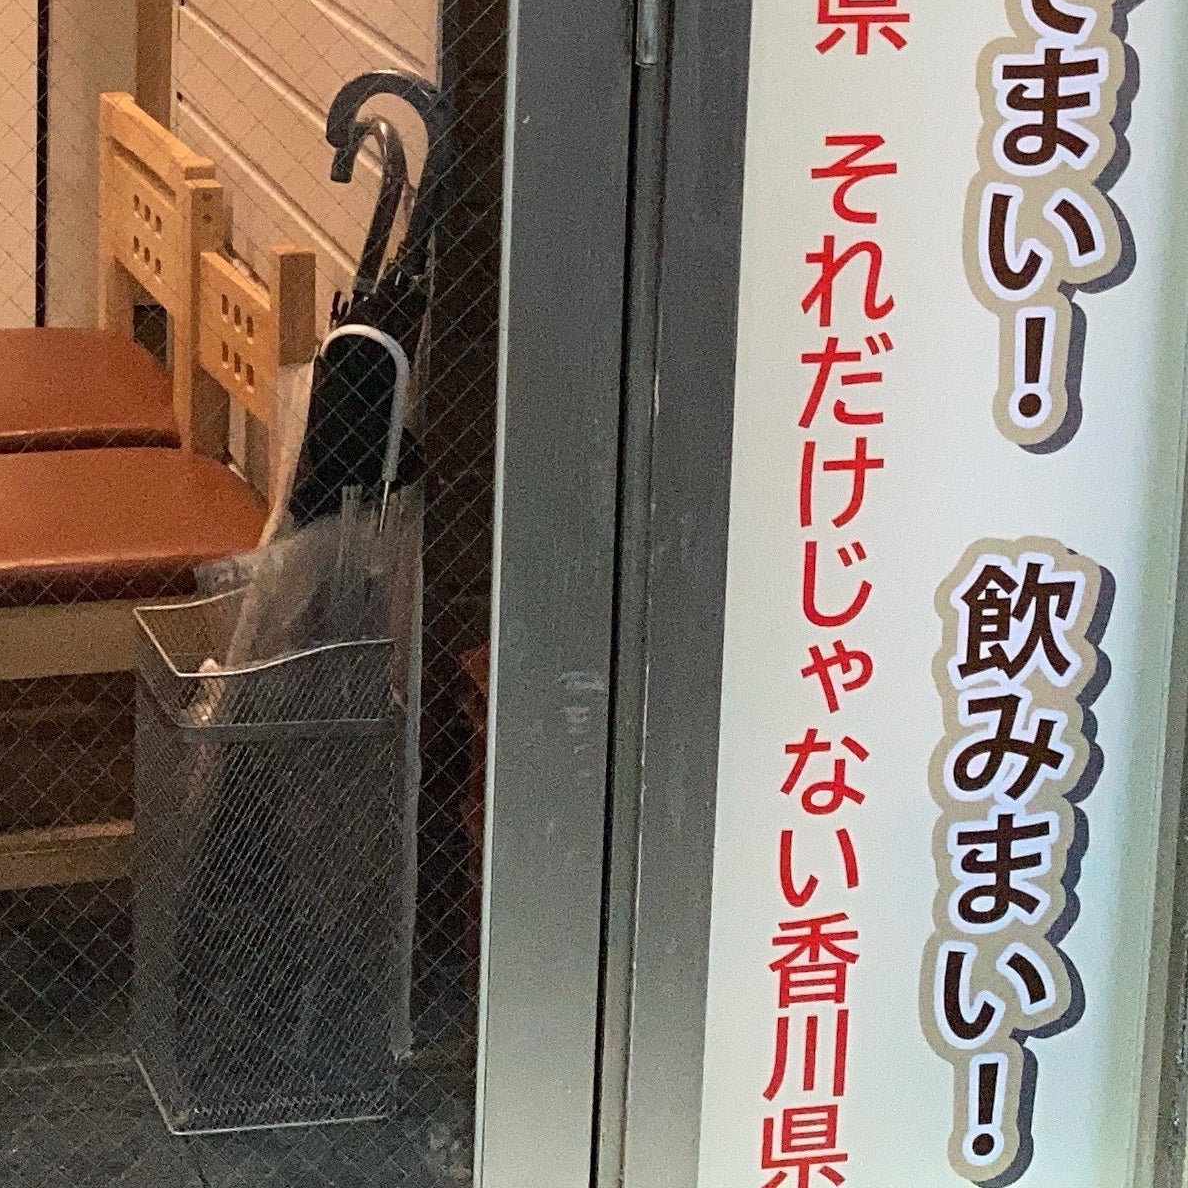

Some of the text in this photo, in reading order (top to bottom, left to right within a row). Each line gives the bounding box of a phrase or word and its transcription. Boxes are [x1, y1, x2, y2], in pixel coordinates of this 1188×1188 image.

[759, 133, 898, 1188] それだけじゃない香川県
